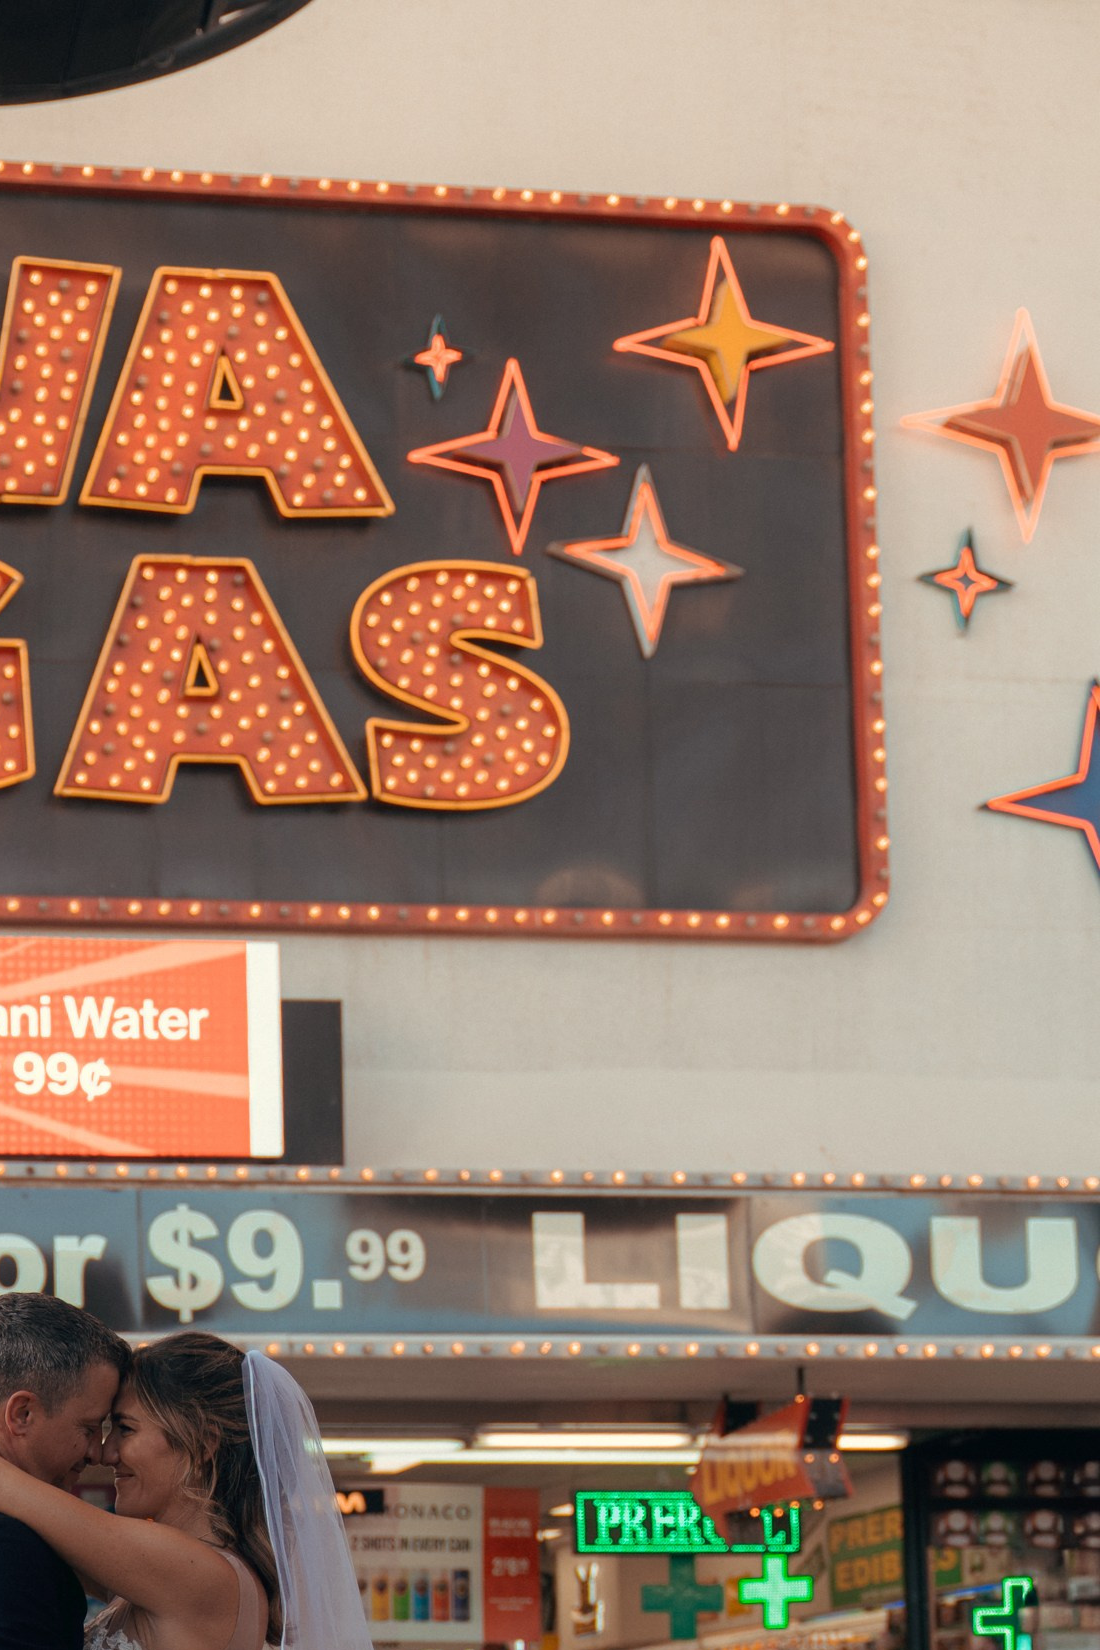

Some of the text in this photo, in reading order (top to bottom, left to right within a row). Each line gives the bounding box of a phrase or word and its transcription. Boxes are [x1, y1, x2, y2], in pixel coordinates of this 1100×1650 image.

[63, 995, 209, 1041] Water
[13, 1052, 111, 1100] 99¢
[532, 1211, 1100, 1321] LIQU
